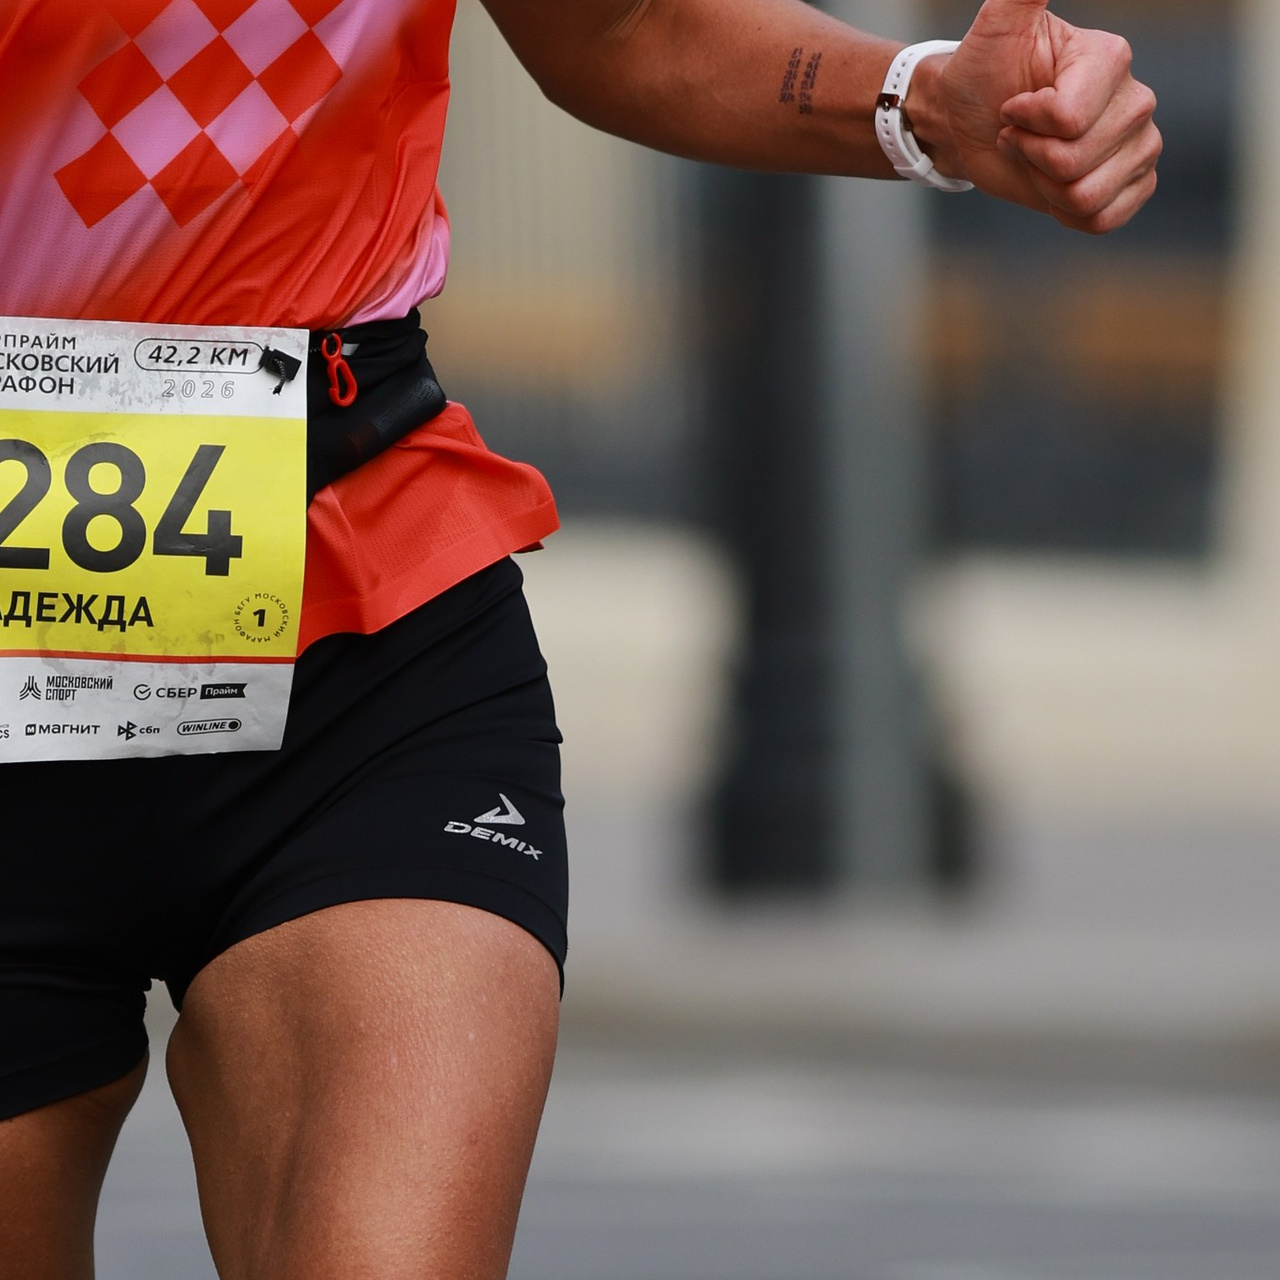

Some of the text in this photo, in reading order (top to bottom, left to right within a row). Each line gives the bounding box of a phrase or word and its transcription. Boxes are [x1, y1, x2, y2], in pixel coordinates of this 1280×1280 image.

[148, 345, 201, 367] 42,2
[161, 378, 235, 398] 2026
[252, 608, 266, 628] 1
[254, 592, 290, 638] МОСКОВСКИЙ
[233, 618, 271, 643] МАРАФОН
[46, 676, 113, 690] МОСКОВСКИЙ
[156, 687, 238, 698] СБЕР Прайм
[46, 689, 76, 701] СПОРТ
[139, 726, 160, 734] сбп
[182, 722, 227, 733] WINLINE
[444, 821, 543, 860] DEMIX
